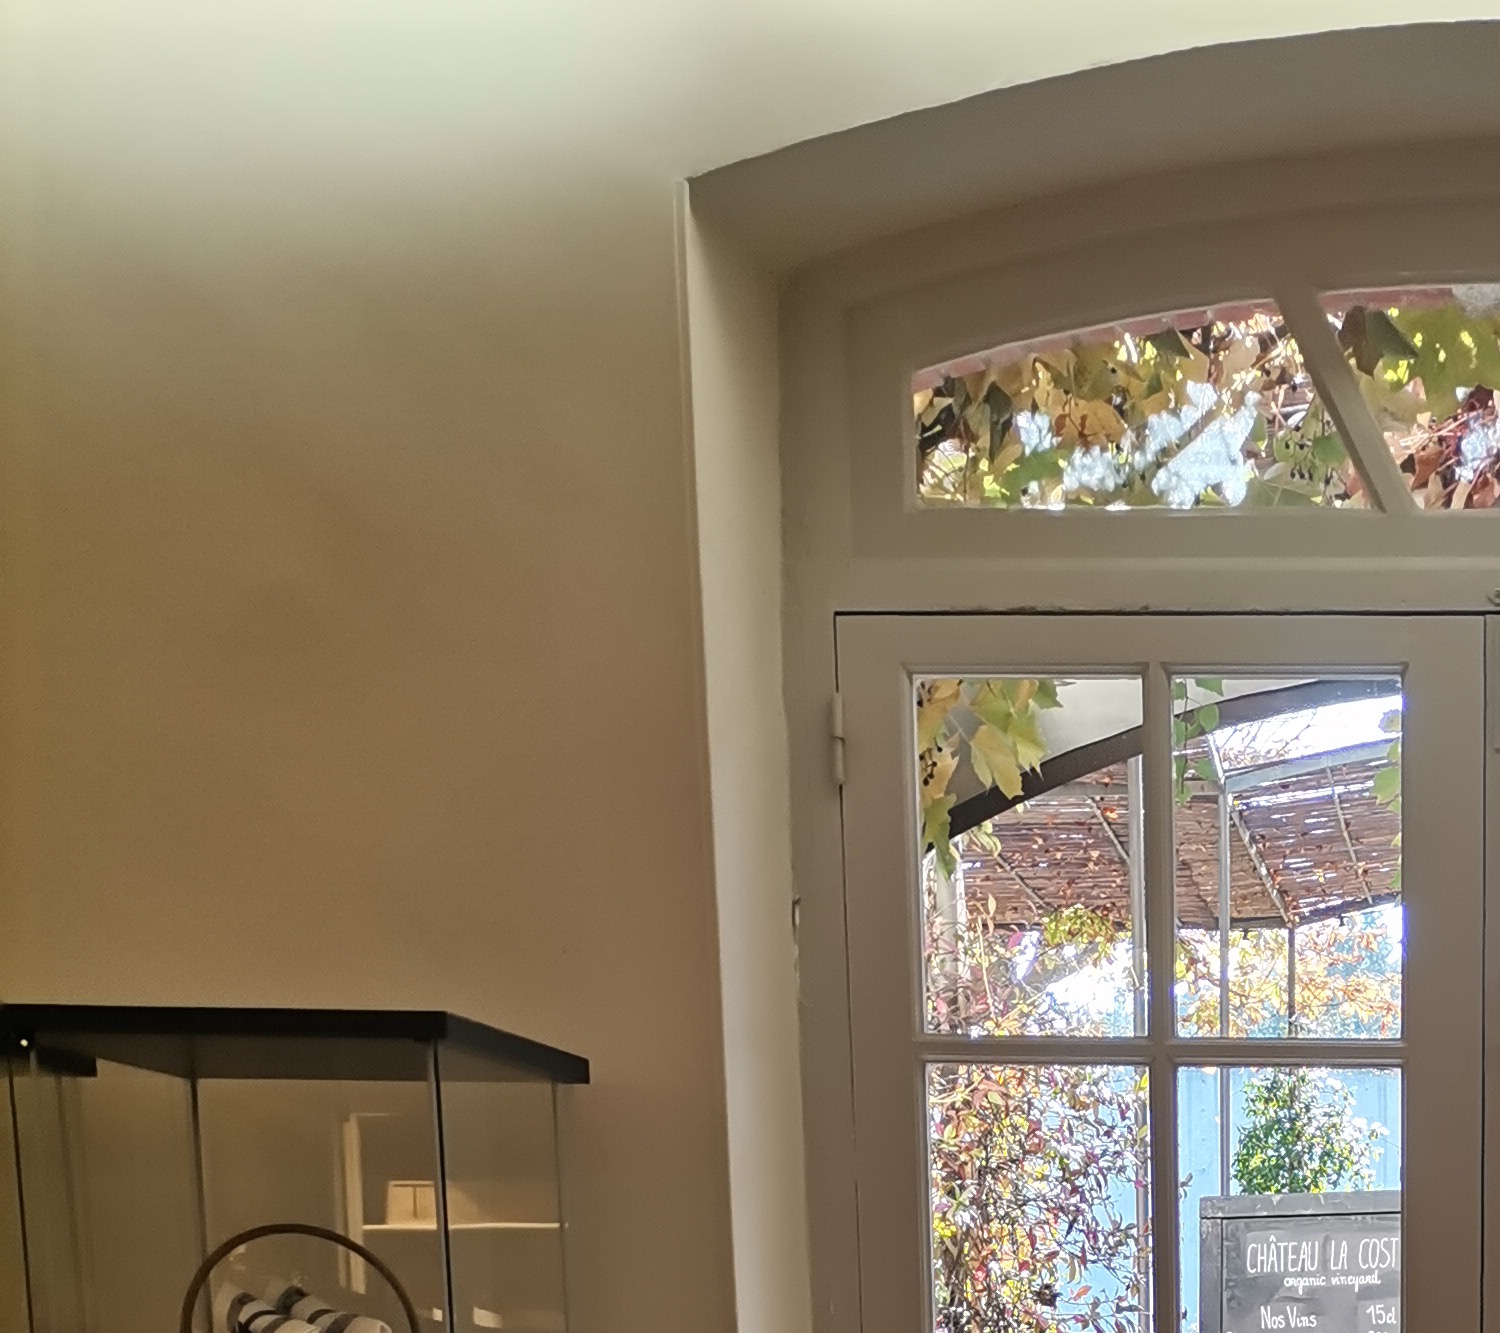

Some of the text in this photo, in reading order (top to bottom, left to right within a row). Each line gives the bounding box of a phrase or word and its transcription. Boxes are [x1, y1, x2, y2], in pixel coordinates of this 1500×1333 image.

[1246, 1234, 1400, 1273] CHÂTEAU LA COST
[1283, 1269, 1382, 1296] organic vineyard
[1260, 1305, 1286, 1330] Nos
[1286, 1305, 1318, 1329] Vins
